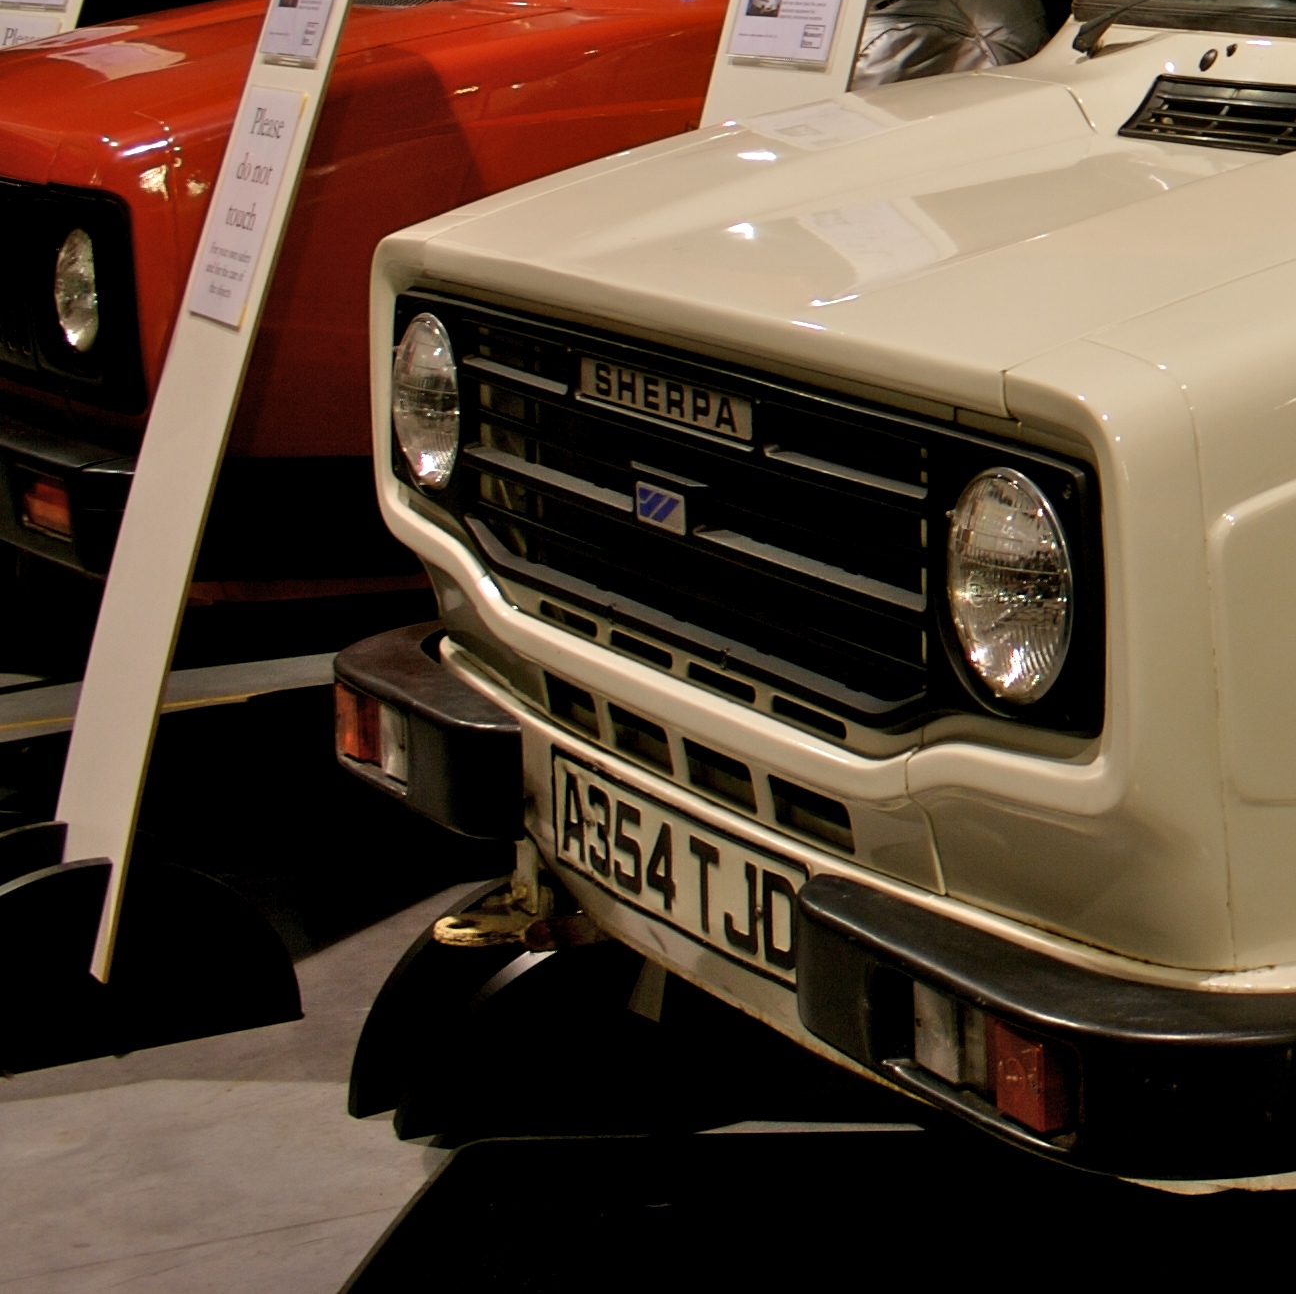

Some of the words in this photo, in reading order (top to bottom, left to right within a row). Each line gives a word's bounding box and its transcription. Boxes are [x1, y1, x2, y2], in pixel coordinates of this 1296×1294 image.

[250, 107, 286, 139] Please
[235, 152, 250, 180] do
[251, 164, 274, 186] not
[225, 203, 258, 232] touch
[594, 362, 738, 434] SHERPA
[563, 768, 678, 915] A354
[689, 833, 798, 972] TJD
